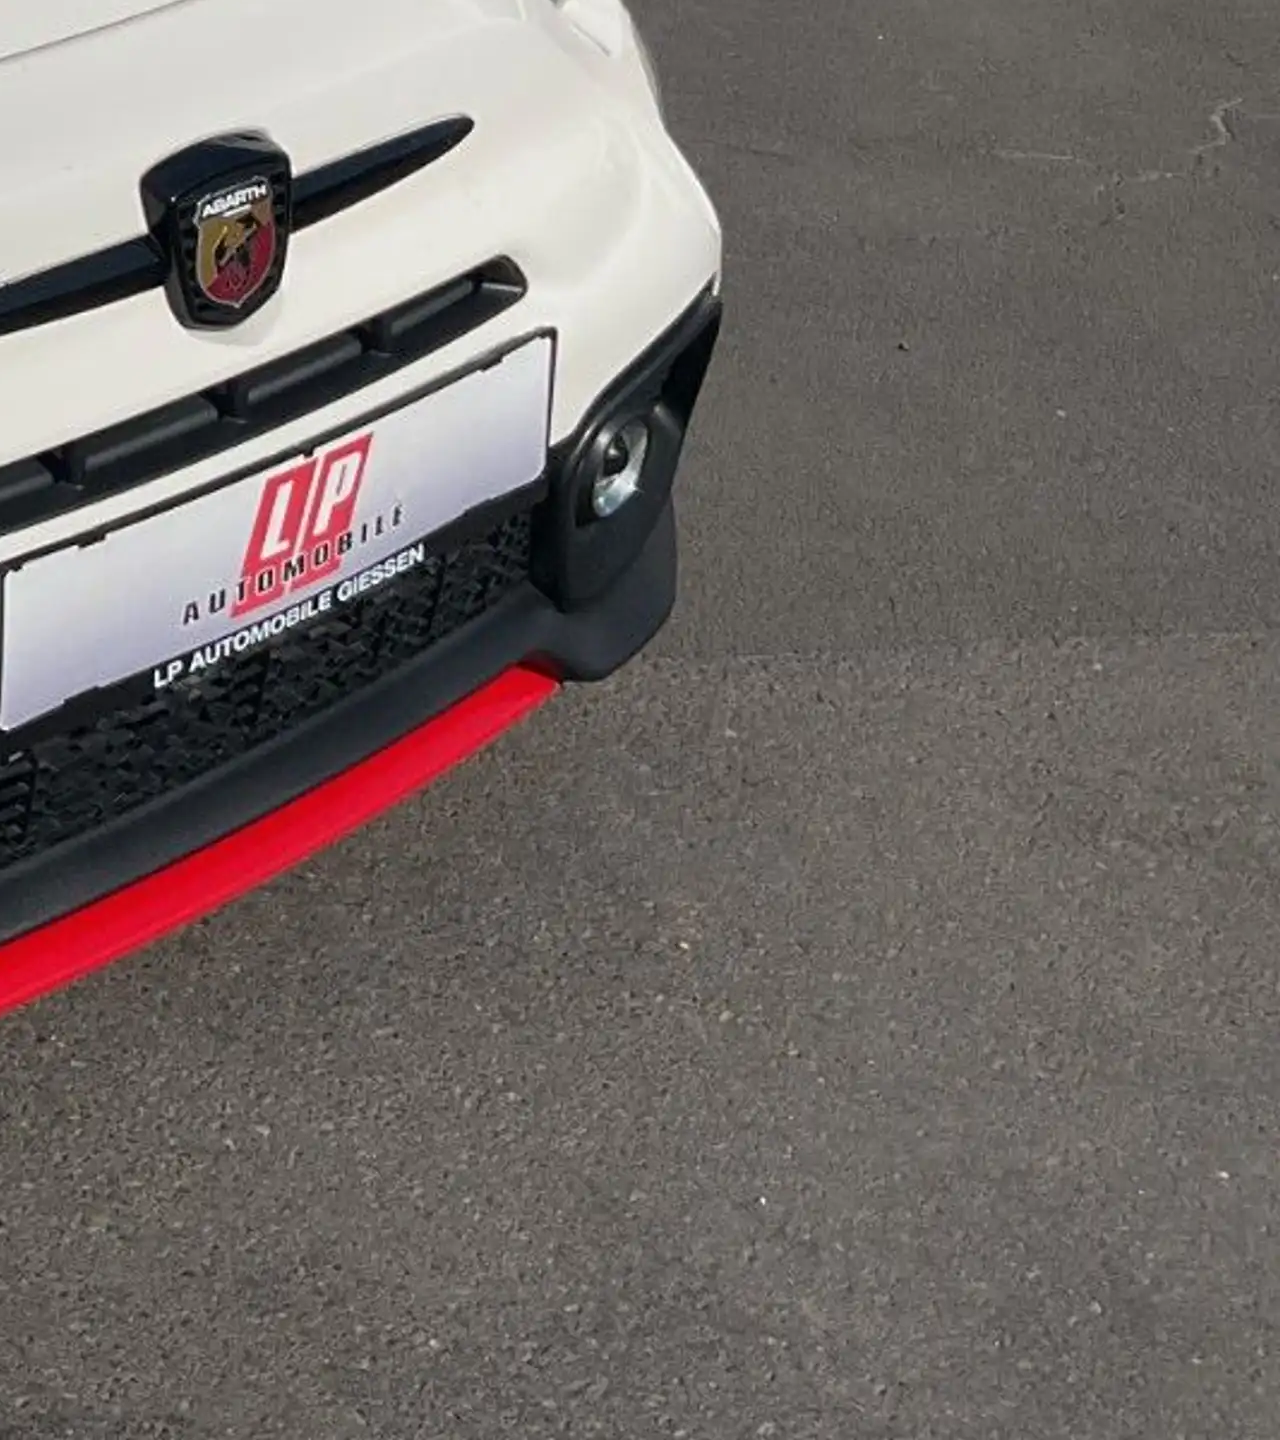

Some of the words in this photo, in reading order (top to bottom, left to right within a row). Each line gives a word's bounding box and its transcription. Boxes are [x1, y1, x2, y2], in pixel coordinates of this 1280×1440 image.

[201, 184, 267, 219] ABARTH
[180, 502, 405, 626] AUTOMOBILE
[259, 449, 362, 561] LP
[153, 661, 183, 689] LP
[188, 589, 333, 674] AUTOMOBILE
[337, 544, 424, 601] GIESSEN
